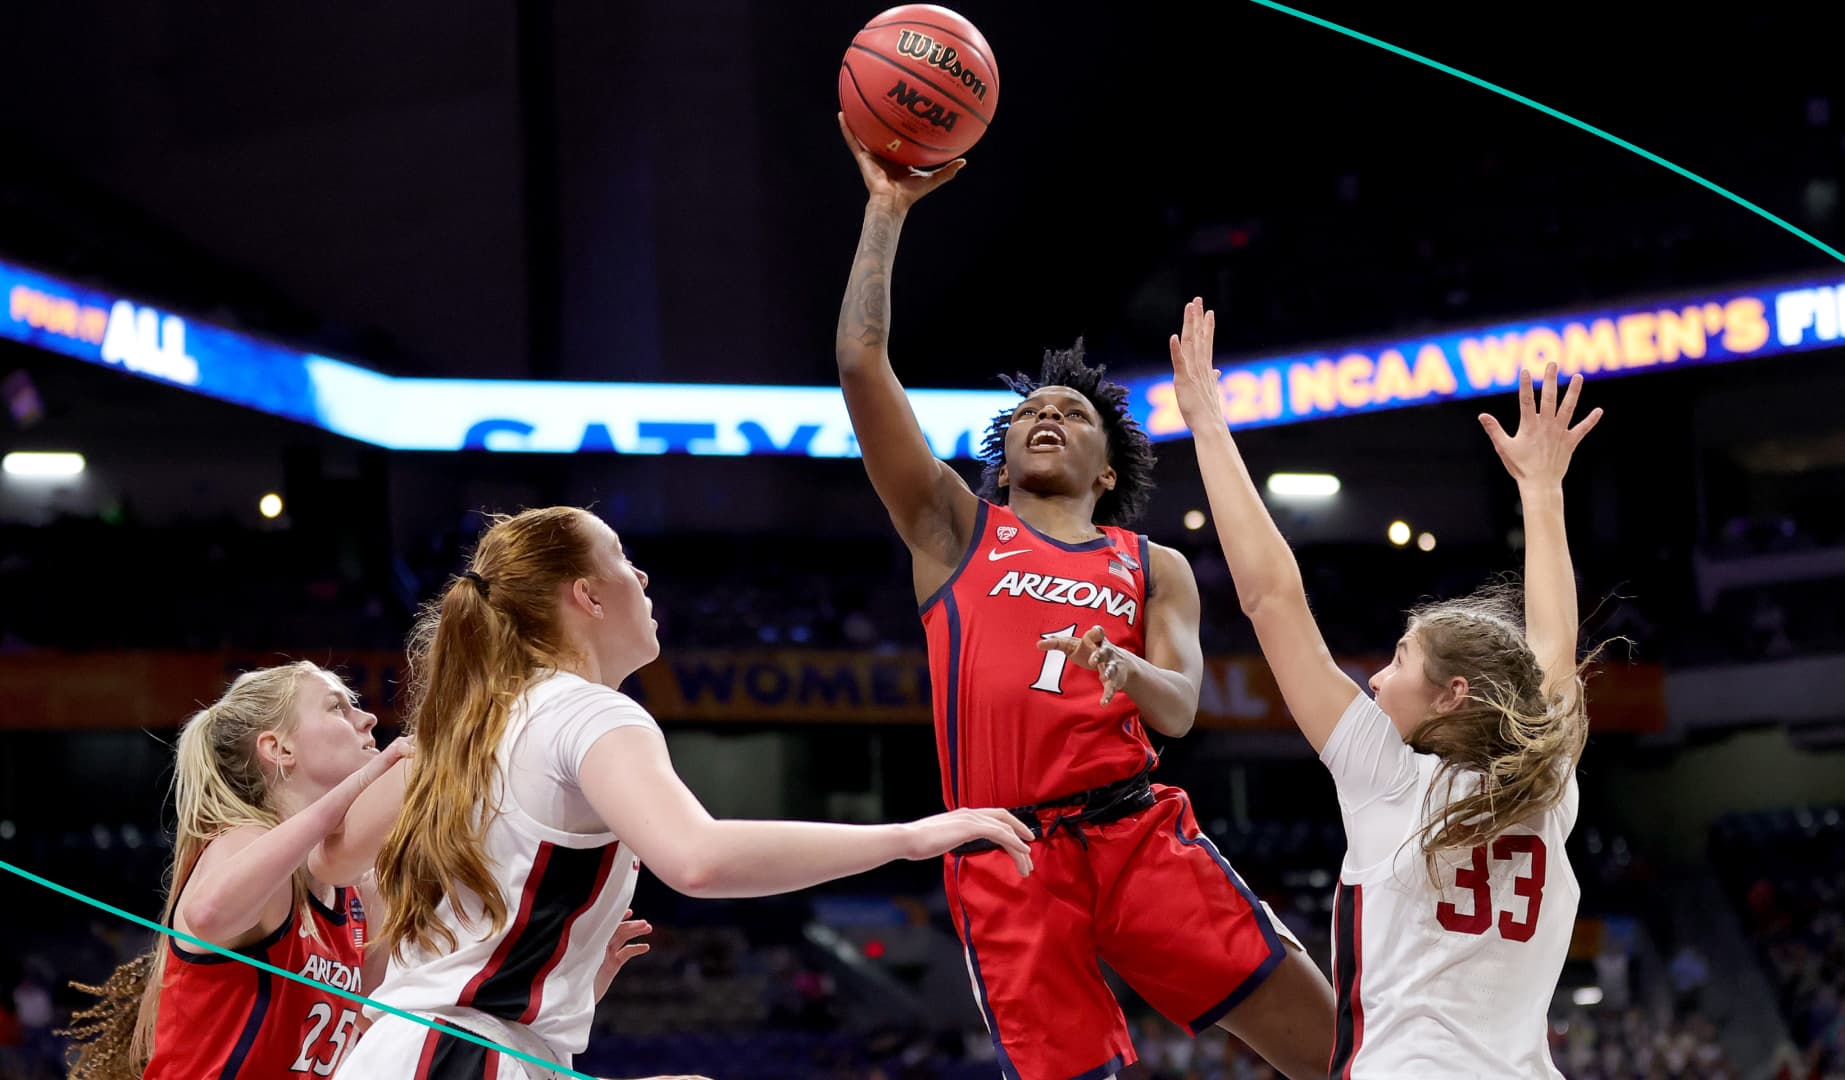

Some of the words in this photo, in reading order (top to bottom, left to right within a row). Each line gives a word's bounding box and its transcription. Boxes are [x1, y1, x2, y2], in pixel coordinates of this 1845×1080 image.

[897, 29, 987, 103] Wilson
[887, 80, 960, 133] NCAA
[101, 299, 199, 386] ALL
[1146, 368, 1282, 435] 221
[1288, 344, 1458, 417] NCAA
[1457, 297, 1770, 390] WOMEN'S
[988, 570, 1137, 626] ARIZONA
[1030, 623, 1077, 694] 1
[1436, 824, 1547, 943] 33
[288, 1001, 358, 1077] 25
